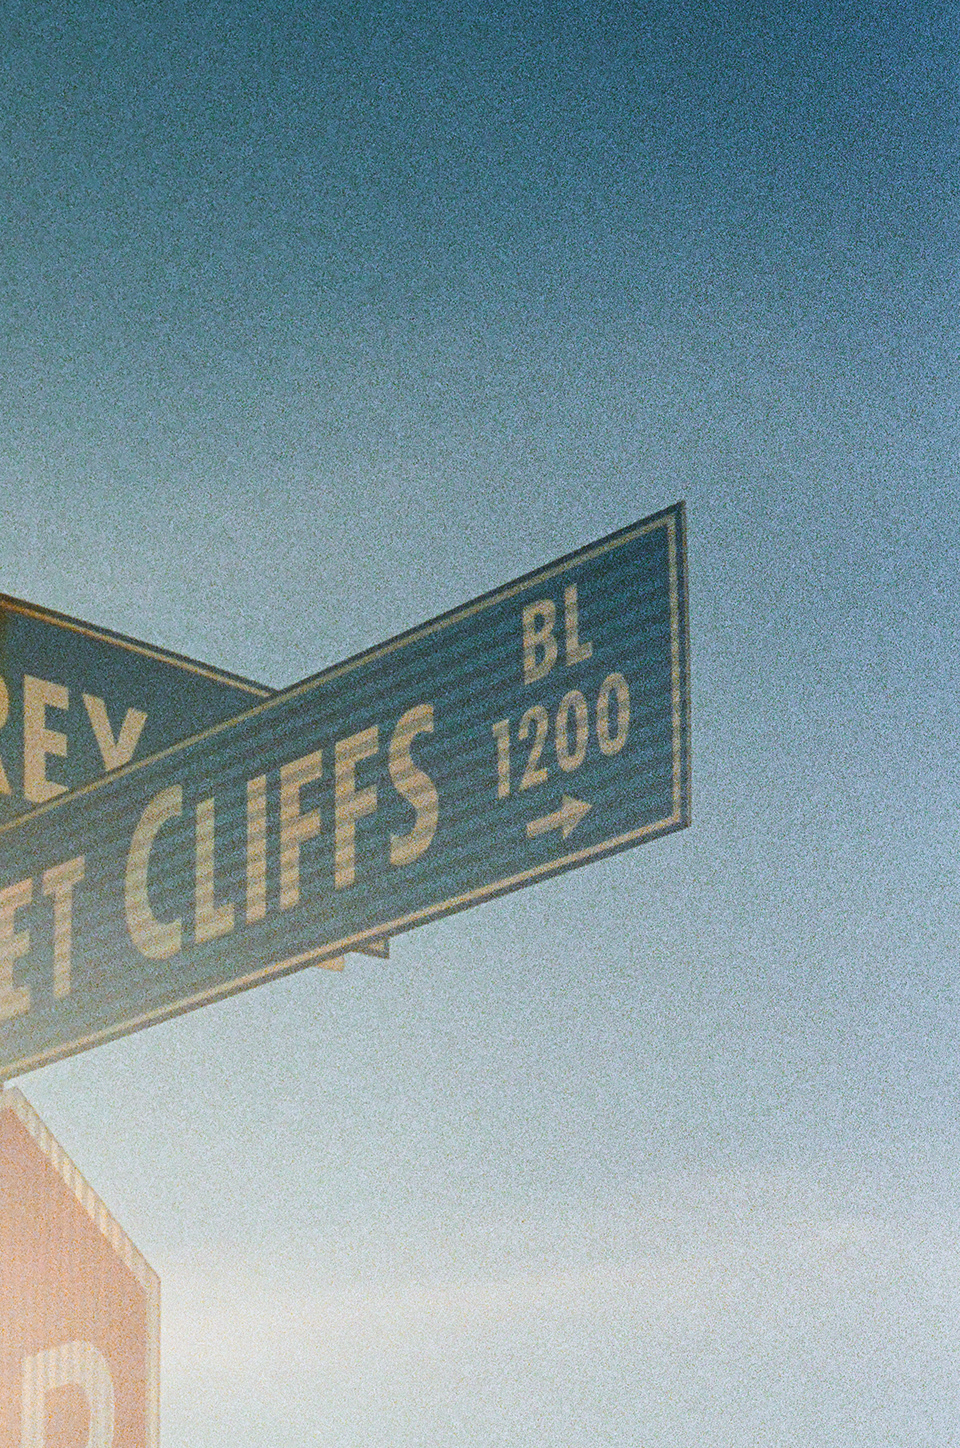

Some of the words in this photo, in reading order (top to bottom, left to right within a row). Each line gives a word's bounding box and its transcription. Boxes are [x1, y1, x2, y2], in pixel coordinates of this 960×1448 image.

[521, 582, 593, 686] BL
[491, 671, 631, 799] 1200
[124, 703, 439, 961] CLIFFS
